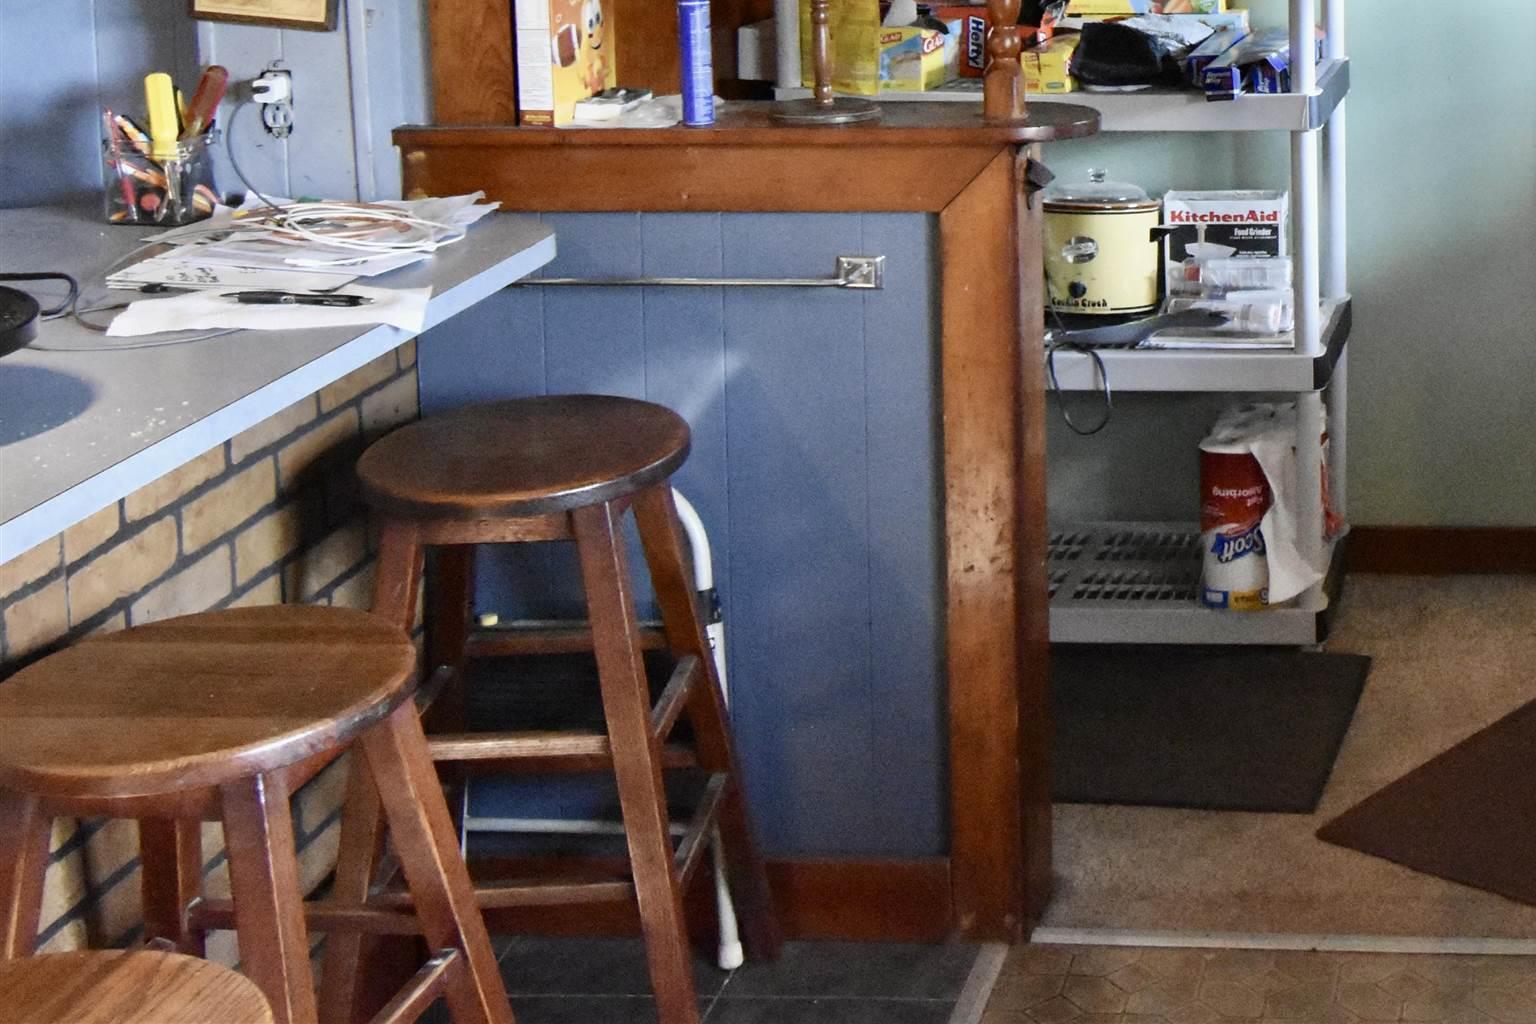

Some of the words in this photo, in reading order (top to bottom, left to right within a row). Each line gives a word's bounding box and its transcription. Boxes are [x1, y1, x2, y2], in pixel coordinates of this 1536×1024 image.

[970, 18, 984, 67] Hefty
[1170, 209, 1278, 223] KitchenAid
[1221, 529, 1263, 563] Scott
